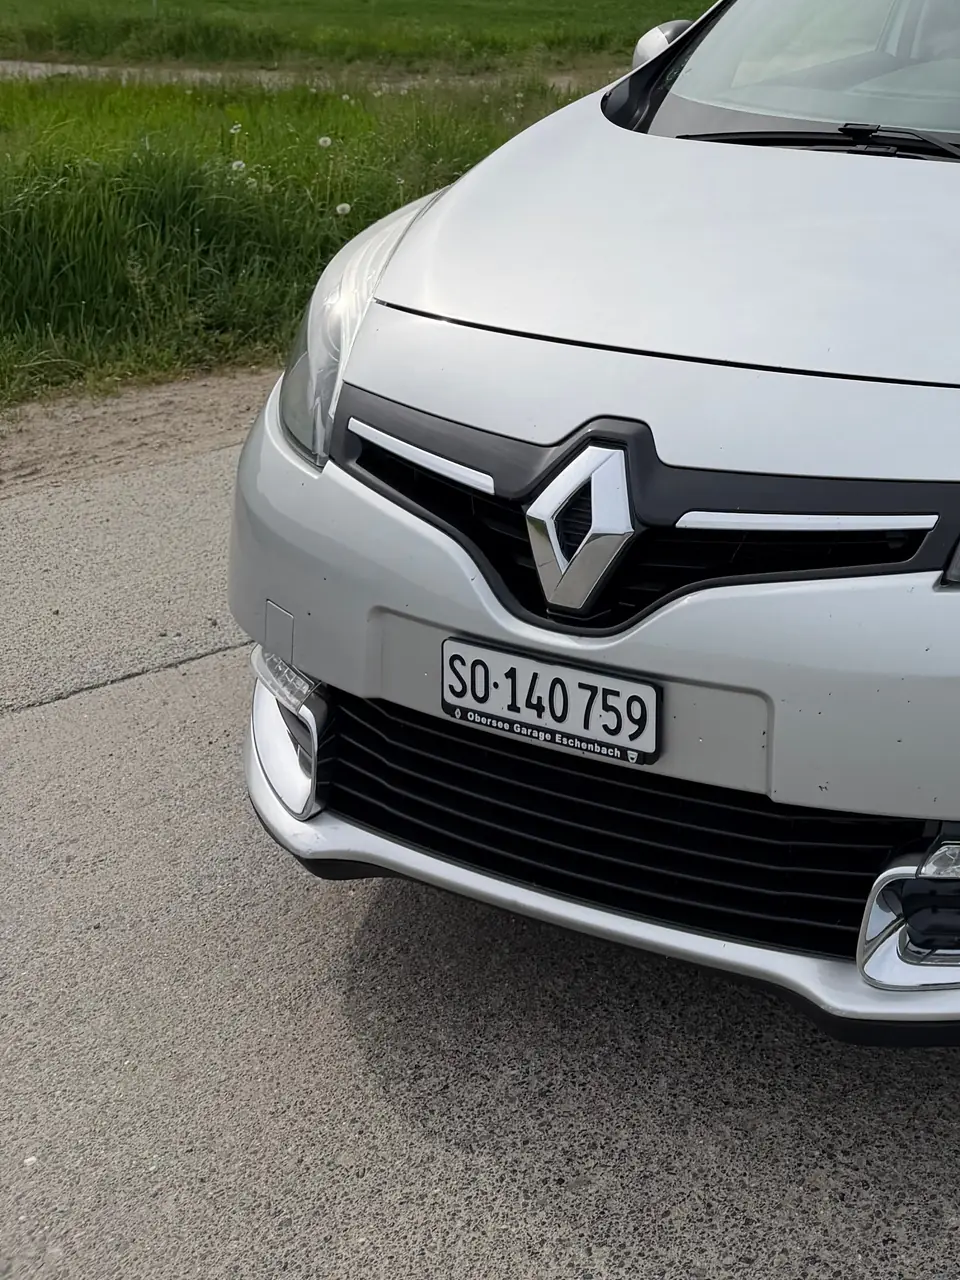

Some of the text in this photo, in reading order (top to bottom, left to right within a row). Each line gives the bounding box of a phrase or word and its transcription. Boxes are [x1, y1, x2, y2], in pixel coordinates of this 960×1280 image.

[467, 712, 620, 758] Obersee Garage Eschenbach
